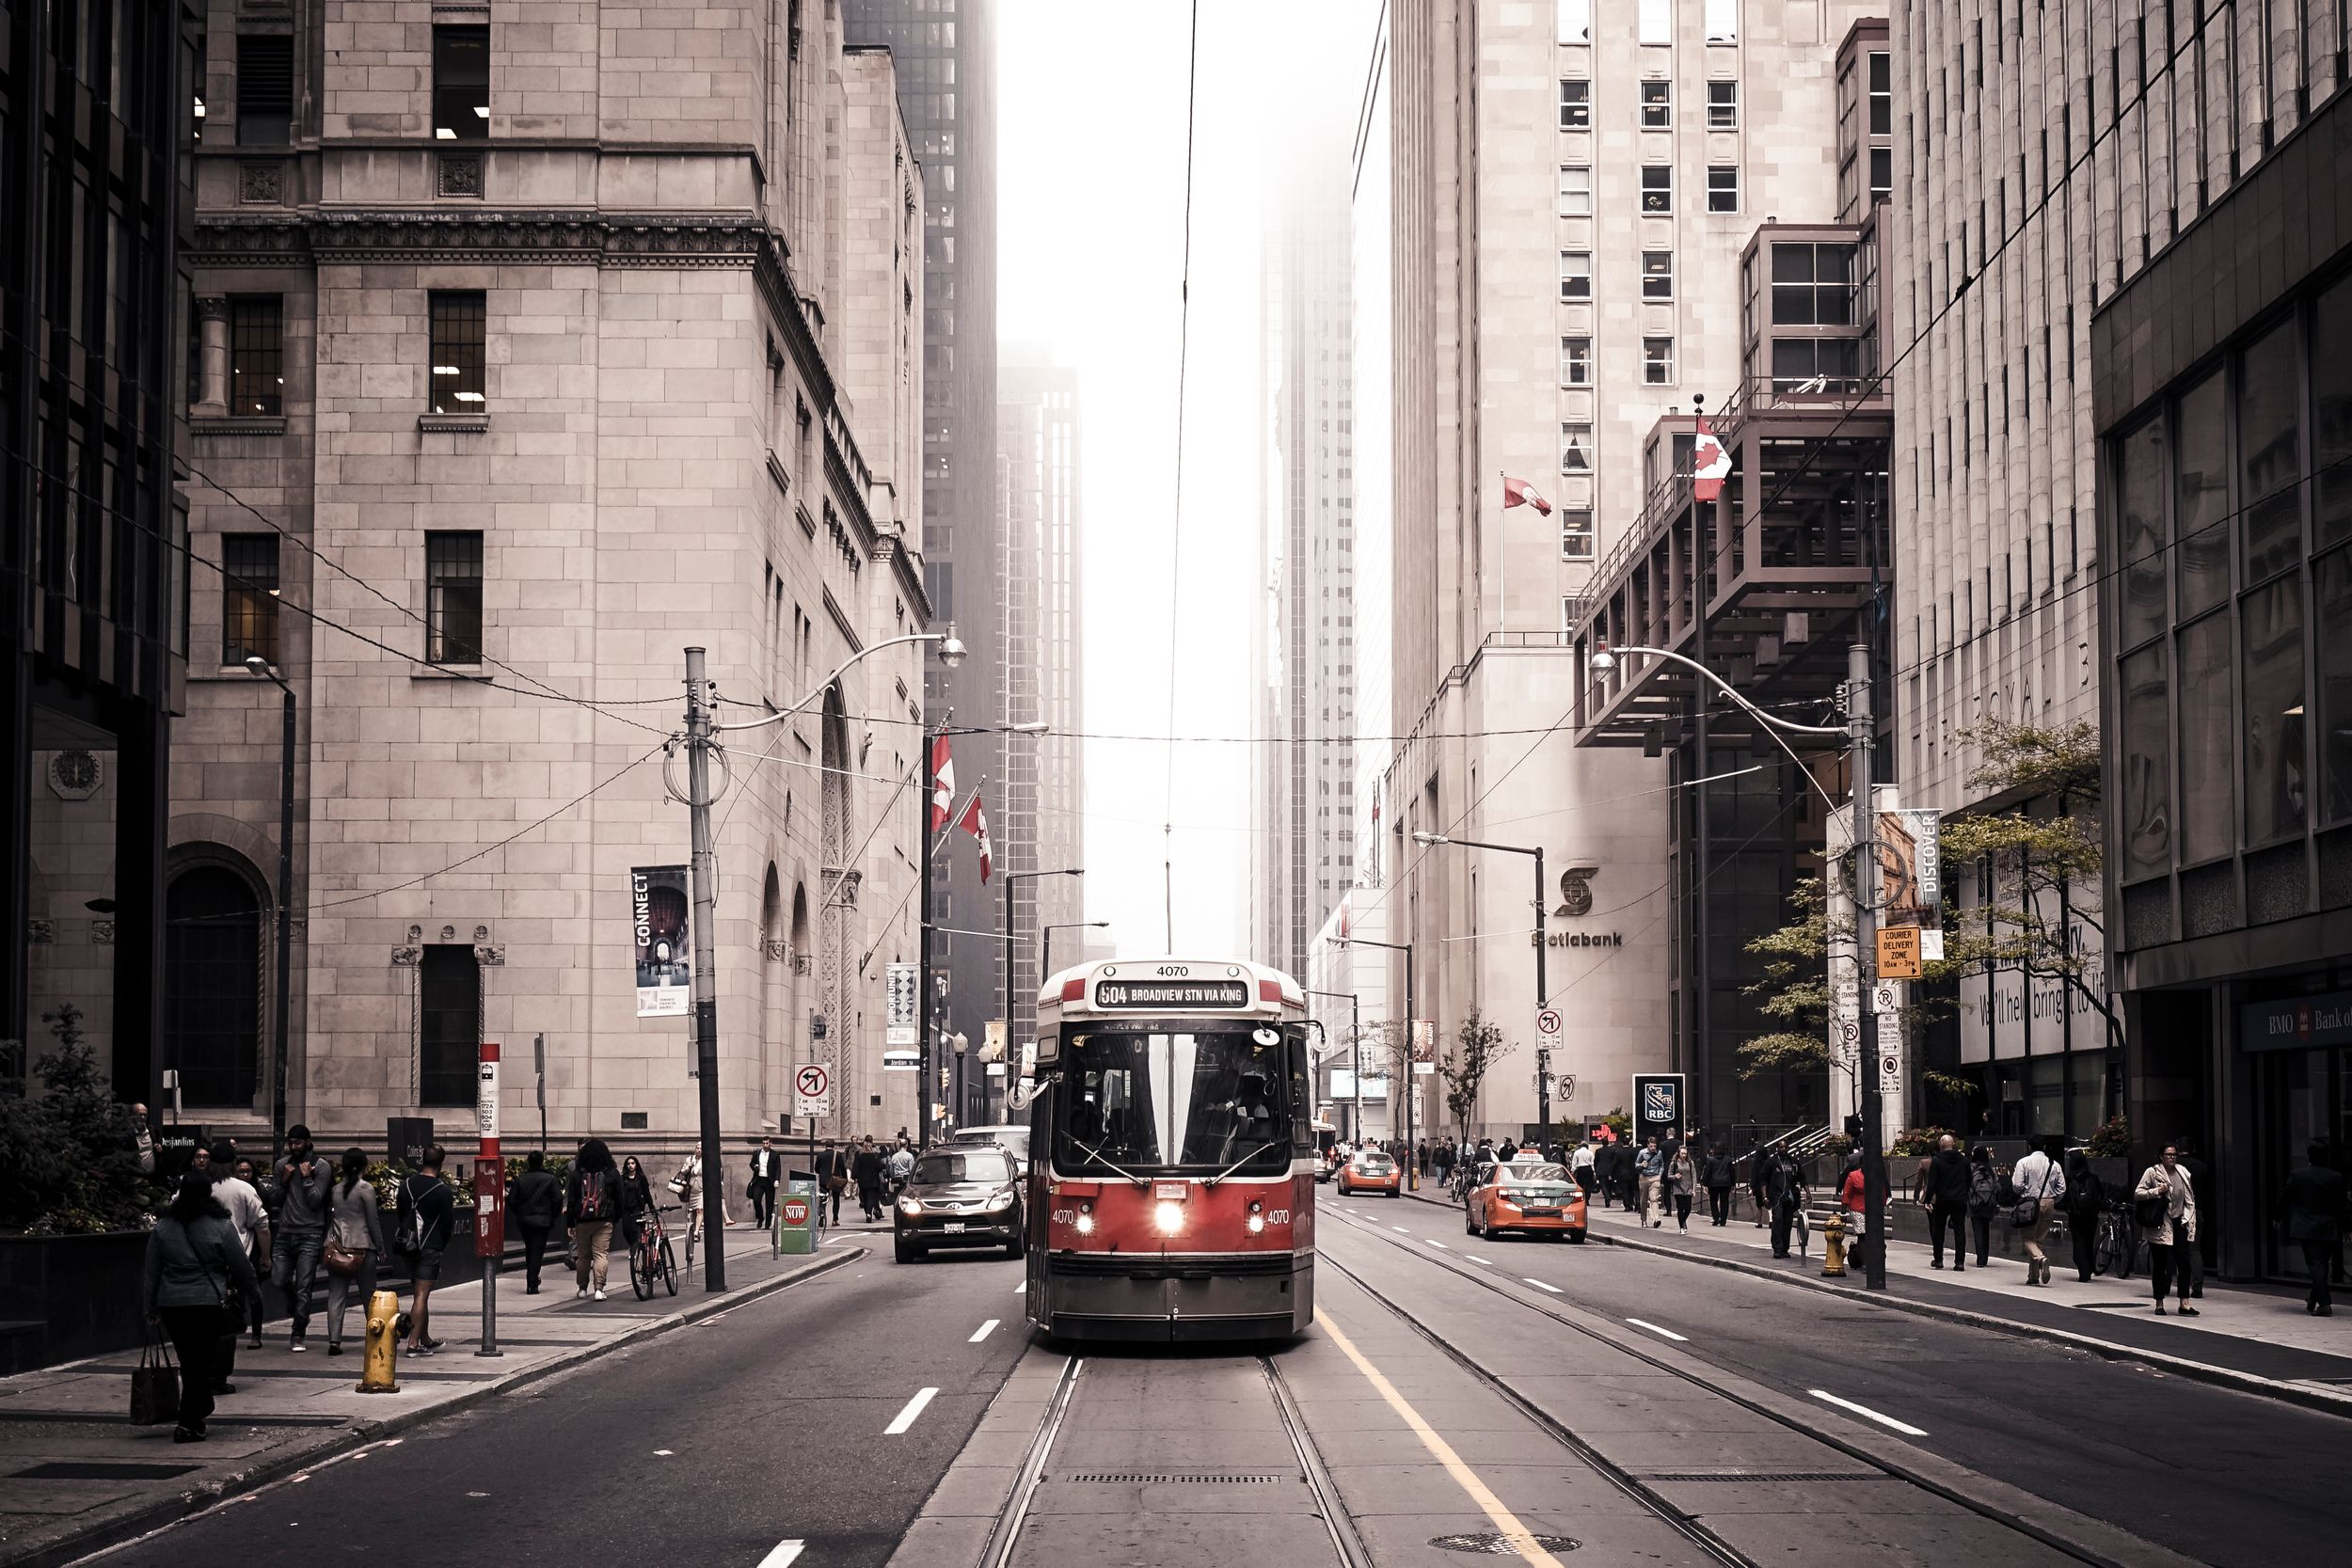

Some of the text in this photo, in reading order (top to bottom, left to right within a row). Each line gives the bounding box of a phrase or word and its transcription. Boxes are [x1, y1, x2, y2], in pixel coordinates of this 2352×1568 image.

[1922, 816, 1937, 893] DISCOVER
[634, 873, 651, 947] CONNECT
[1531, 931, 1623, 947] Sotiabank
[1885, 930, 1912, 940] COURIER
[1883, 941, 1914, 950] DELIVERY
[1891, 951, 1908, 959] ZONE
[1157, 966, 1188, 977] 4070
[887, 967, 897, 1025] OPPORTUNITY
[1101, 986, 1242, 1004] 504 BROADVIEW STN VIA KING
[2007, 985, 2025, 1022] hel
[2034, 982, 2062, 1024] bring
[2268, 1014, 2294, 1035] BMO
[2315, 1007, 2342, 1030] Bank
[1649, 1110, 1672, 1118] RBC
[785, 1205, 807, 1219] NOW
[1052, 1209, 1290, 1225] 4070 4070
